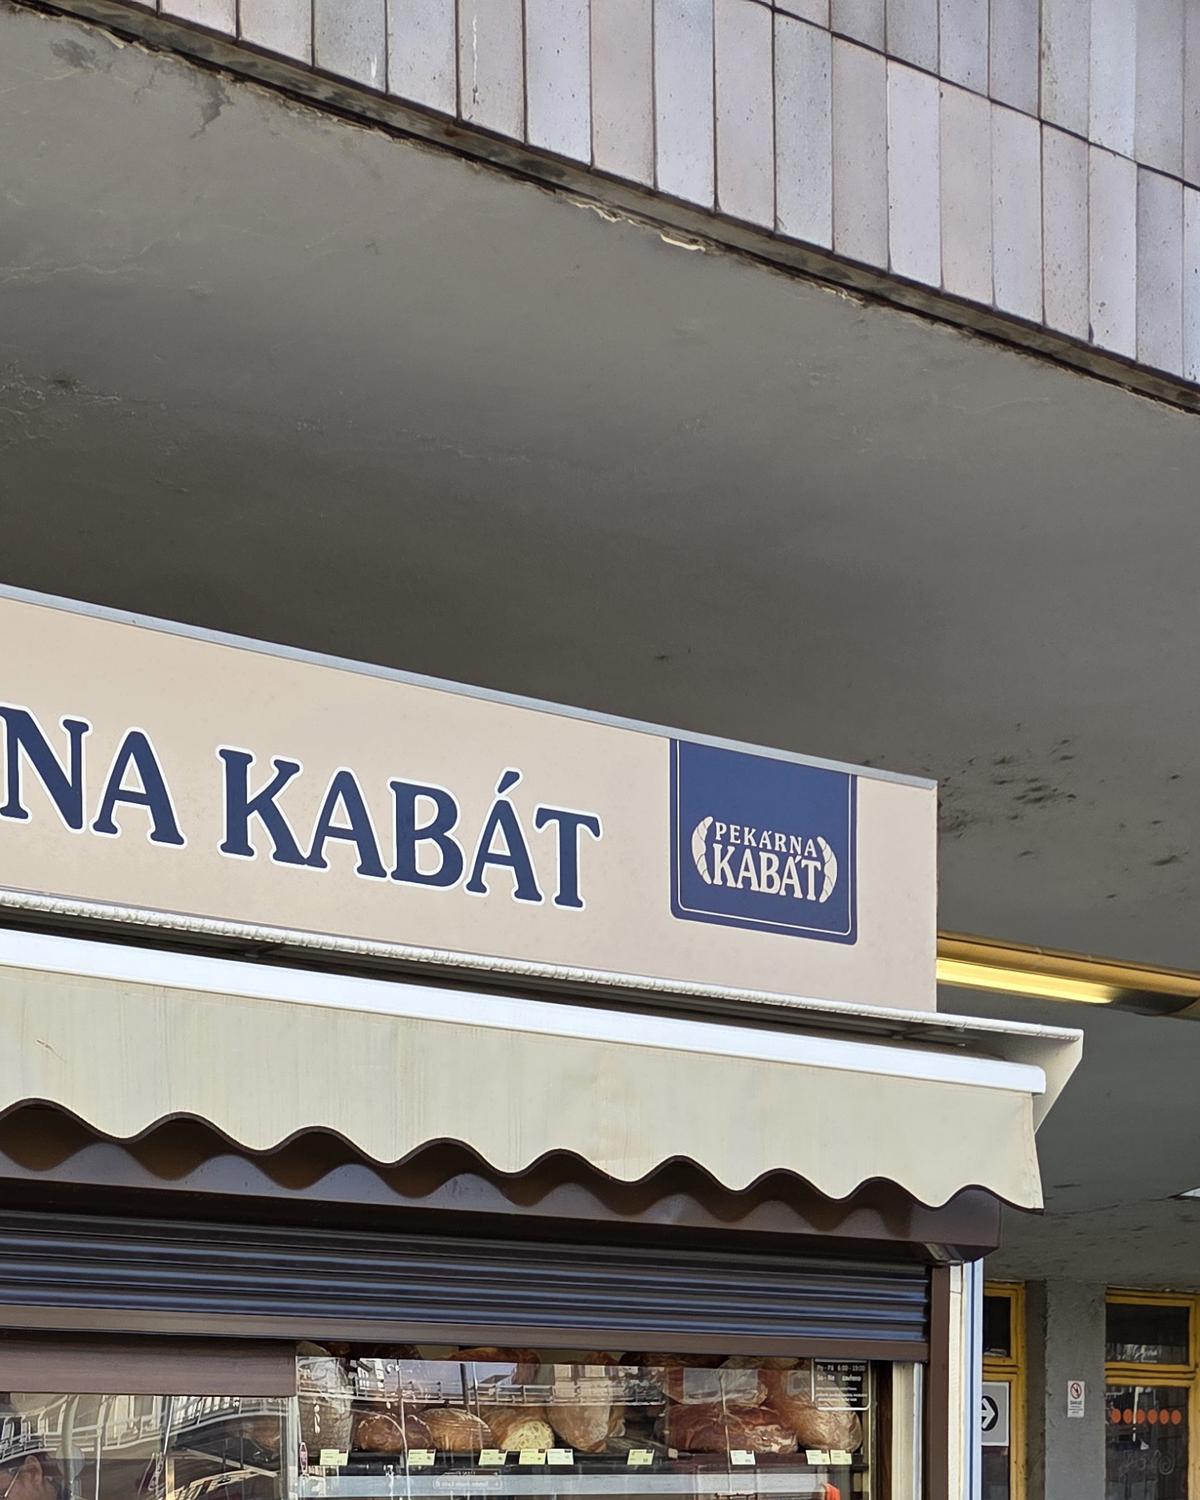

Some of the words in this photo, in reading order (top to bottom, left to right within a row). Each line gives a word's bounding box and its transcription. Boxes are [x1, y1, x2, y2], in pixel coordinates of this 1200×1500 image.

[217, 746, 602, 908] KABÁT
[714, 821, 818, 859] PEKÁRNA
[712, 842, 822, 902] KABÁT
